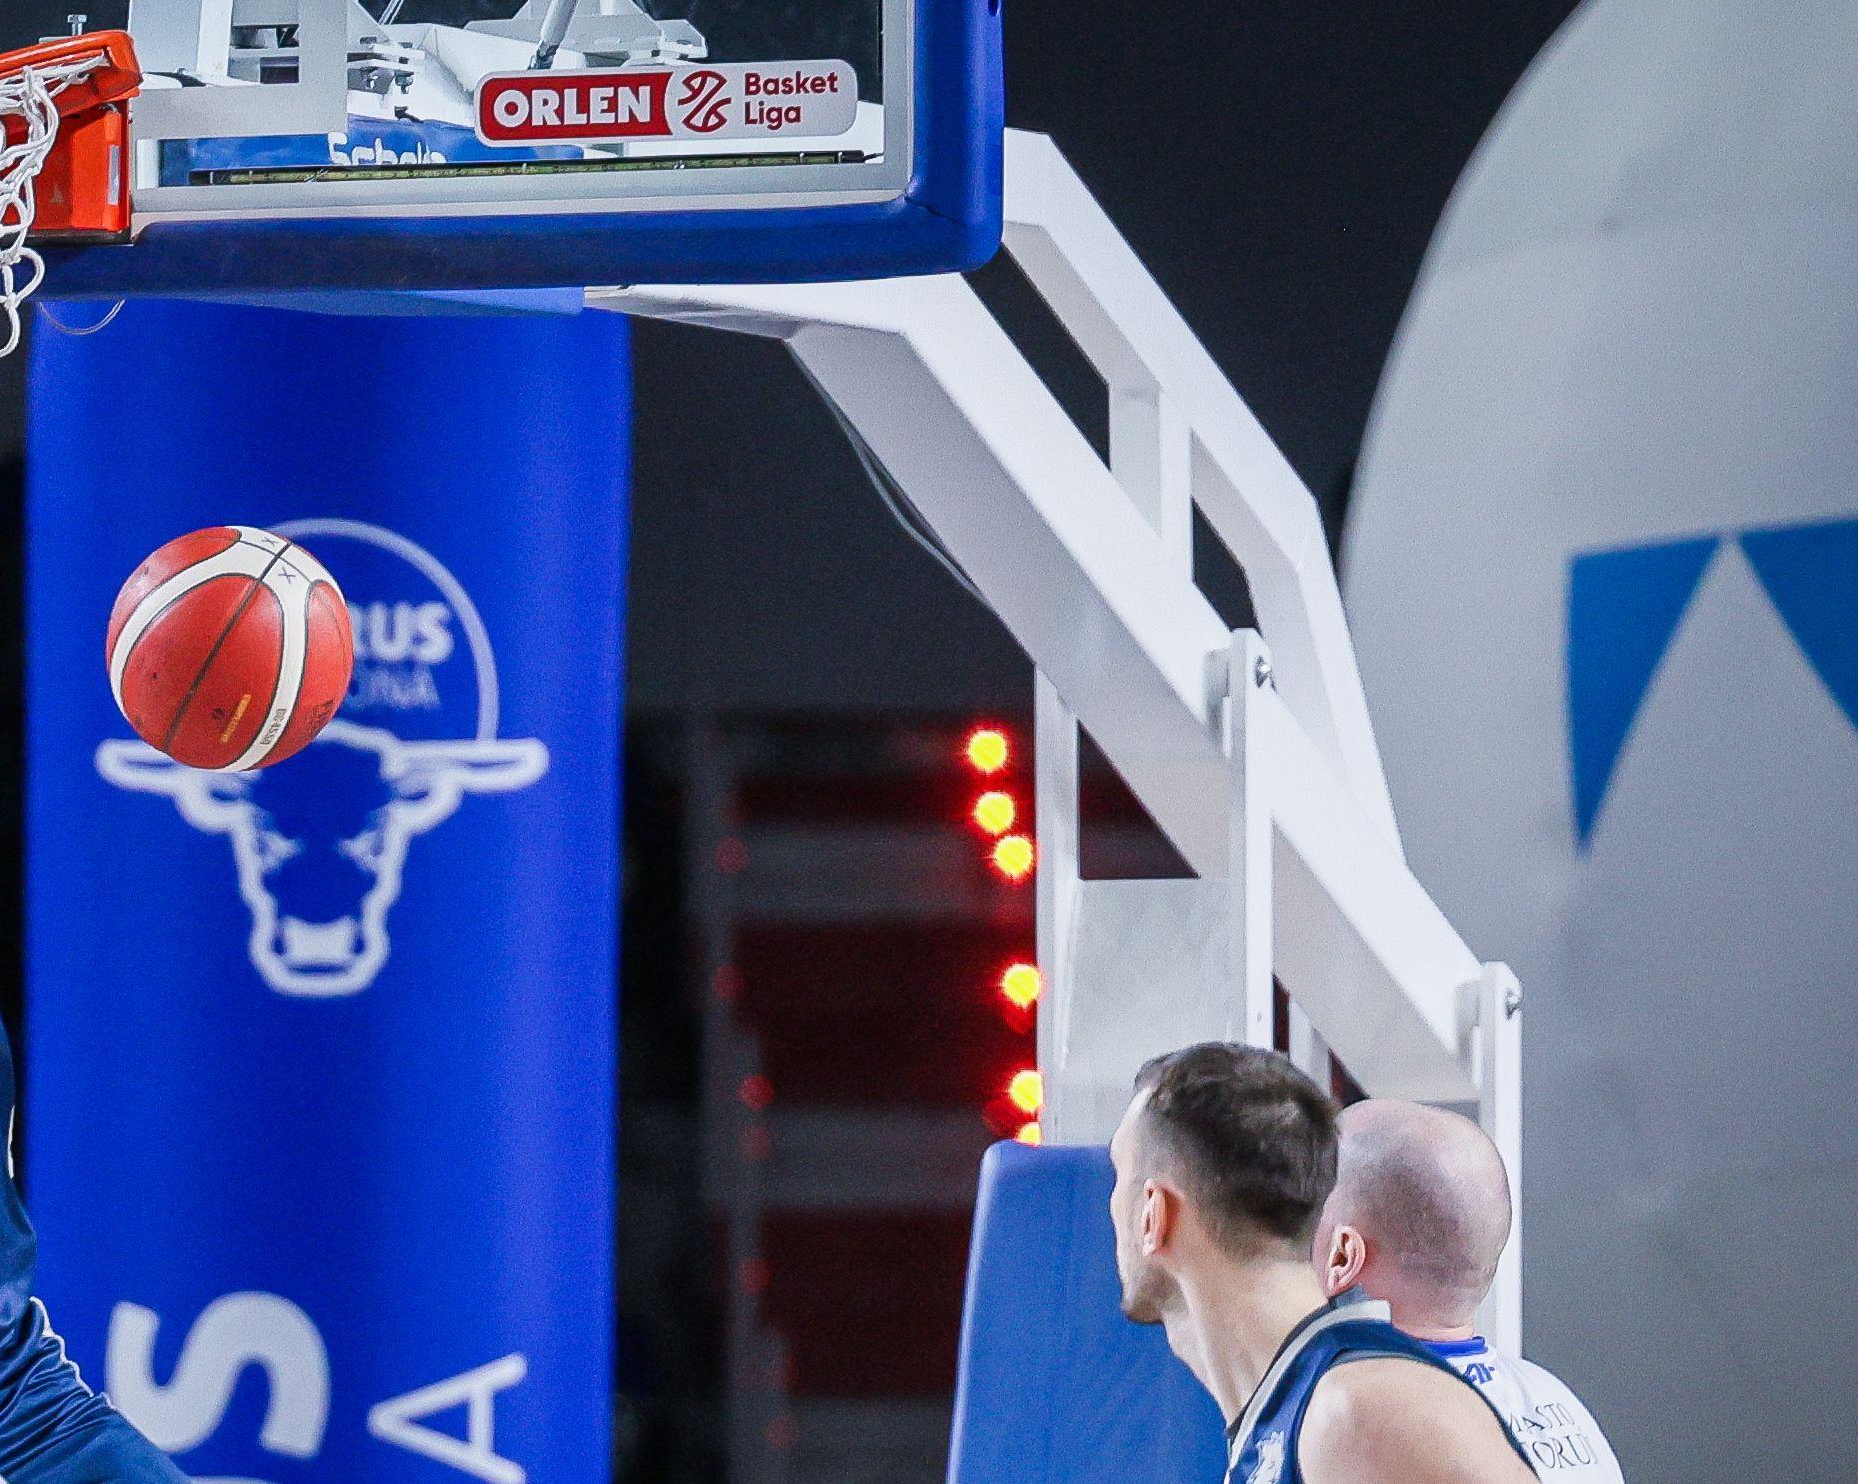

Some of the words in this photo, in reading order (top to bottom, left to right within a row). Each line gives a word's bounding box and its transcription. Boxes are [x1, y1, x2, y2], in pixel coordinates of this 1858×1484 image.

[744, 70, 839, 97] Basket
[493, 85, 652, 128] ORLEN
[744, 101, 802, 131] Liga
